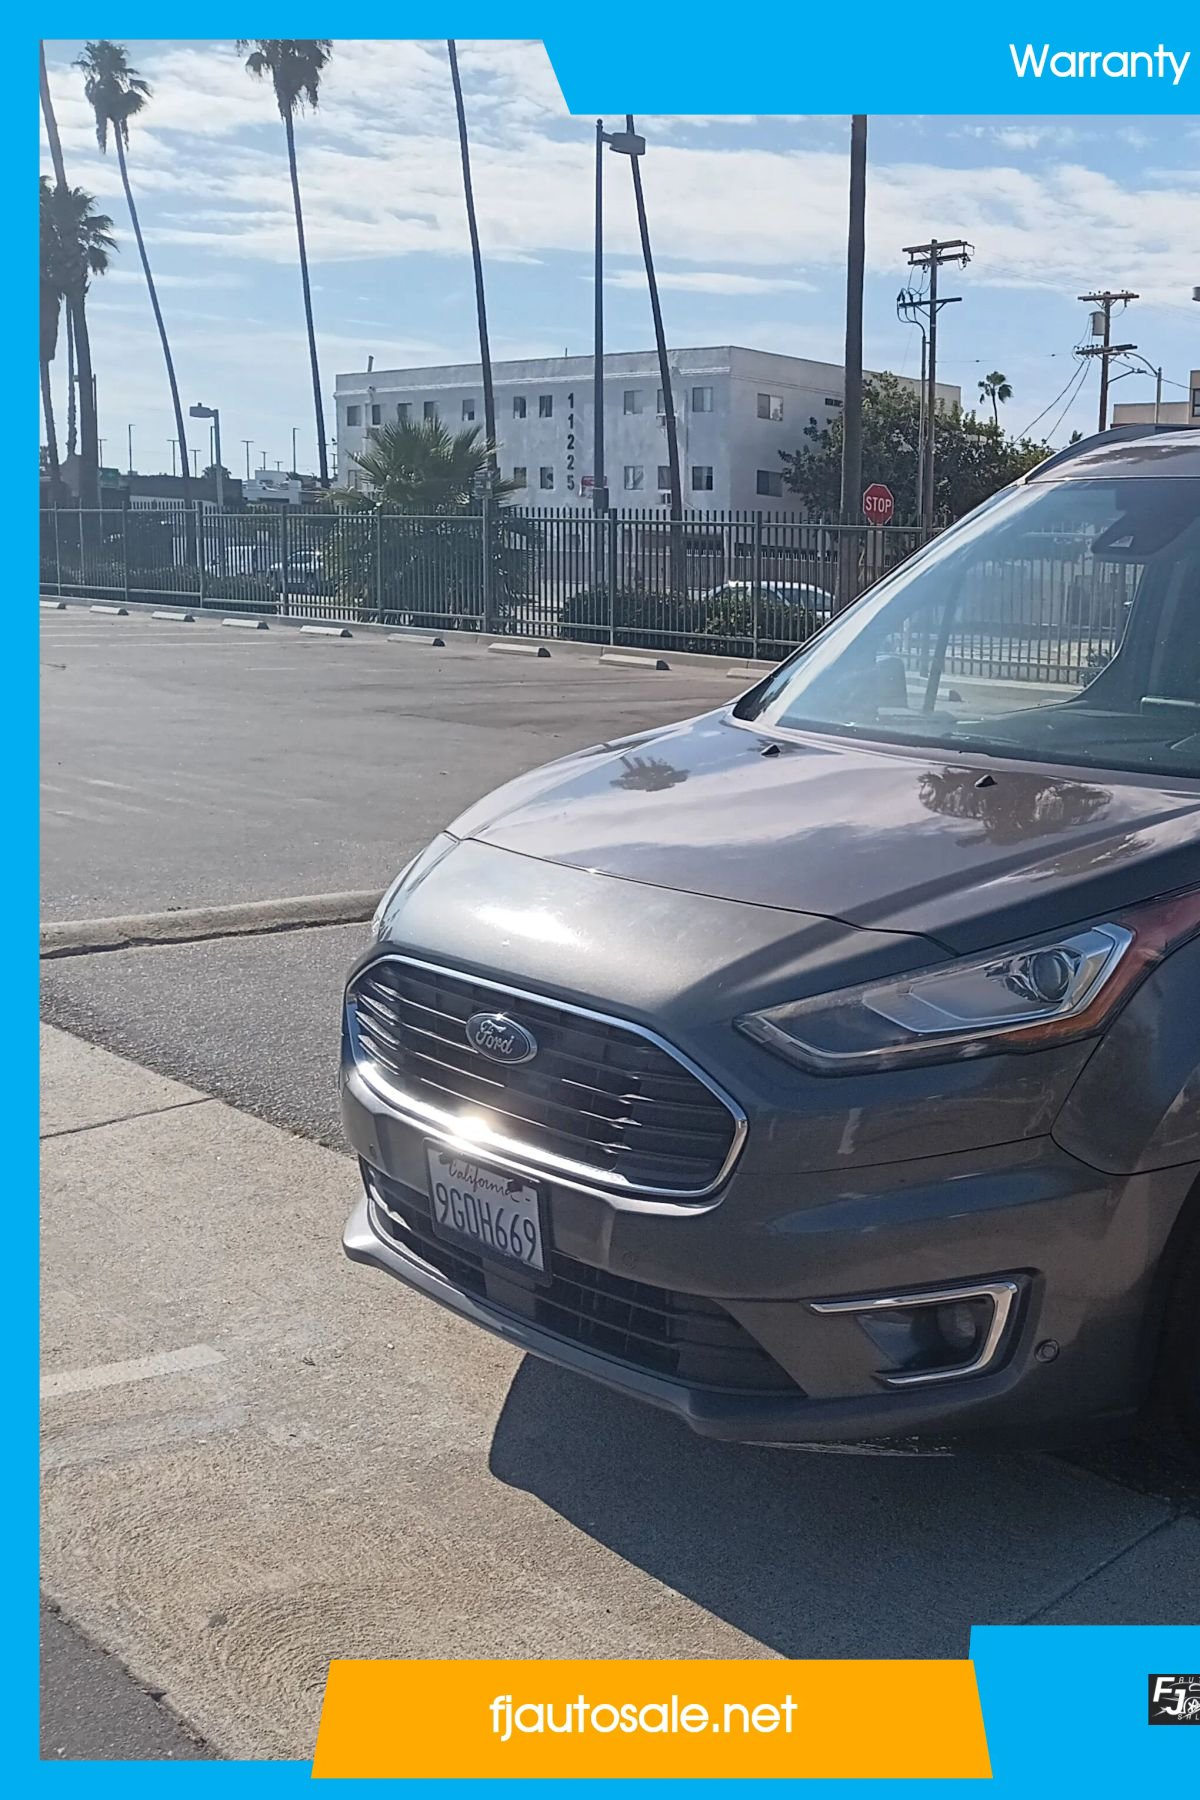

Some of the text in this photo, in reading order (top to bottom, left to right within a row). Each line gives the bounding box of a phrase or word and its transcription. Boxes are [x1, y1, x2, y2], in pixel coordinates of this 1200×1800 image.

[567, 392, 575, 491] 11225
[865, 496, 892, 513] STOP
[475, 1019, 515, 1055] Ford
[436, 1182, 537, 1263] 9GDH669
